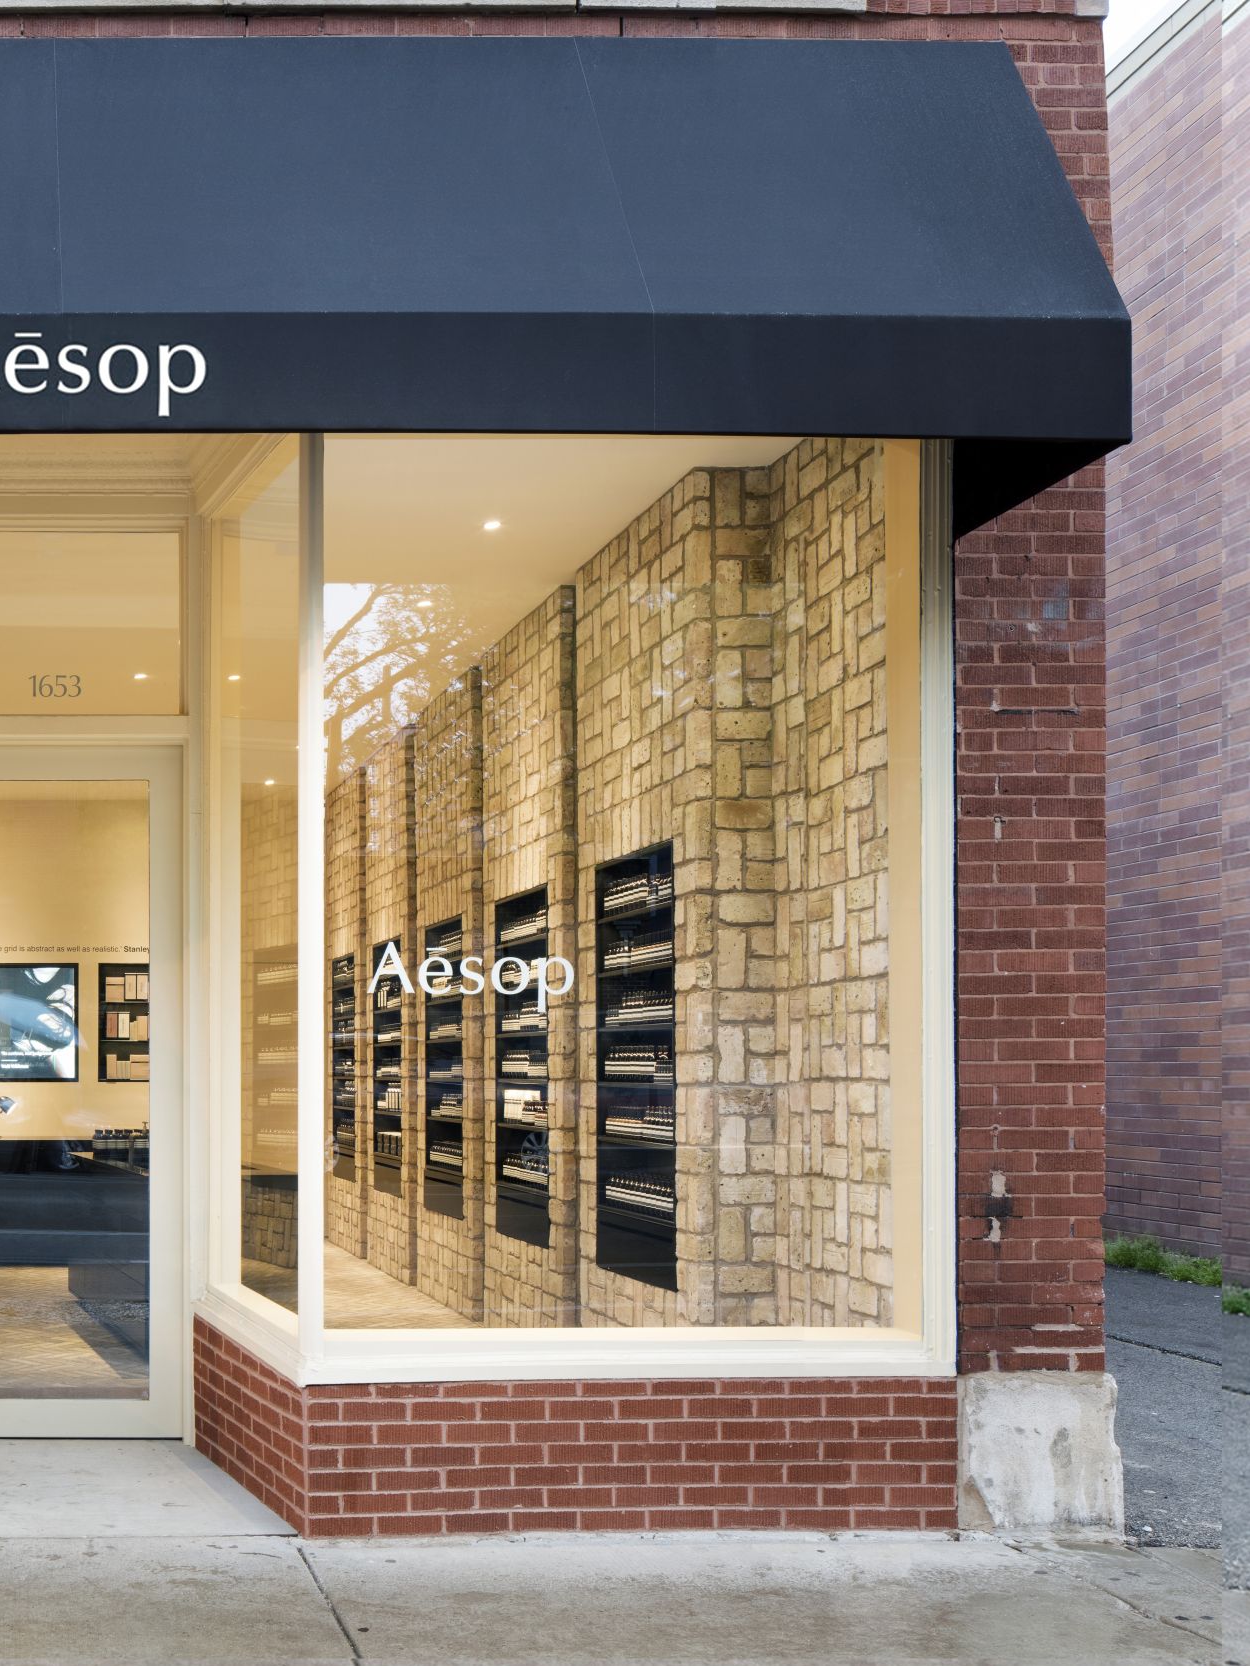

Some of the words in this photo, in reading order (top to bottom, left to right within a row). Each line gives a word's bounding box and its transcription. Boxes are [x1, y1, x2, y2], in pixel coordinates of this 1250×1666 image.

[28, 674, 82, 698] 1653
[4, 945, 17, 954] grid
[366, 941, 575, 1013] Aēsop
